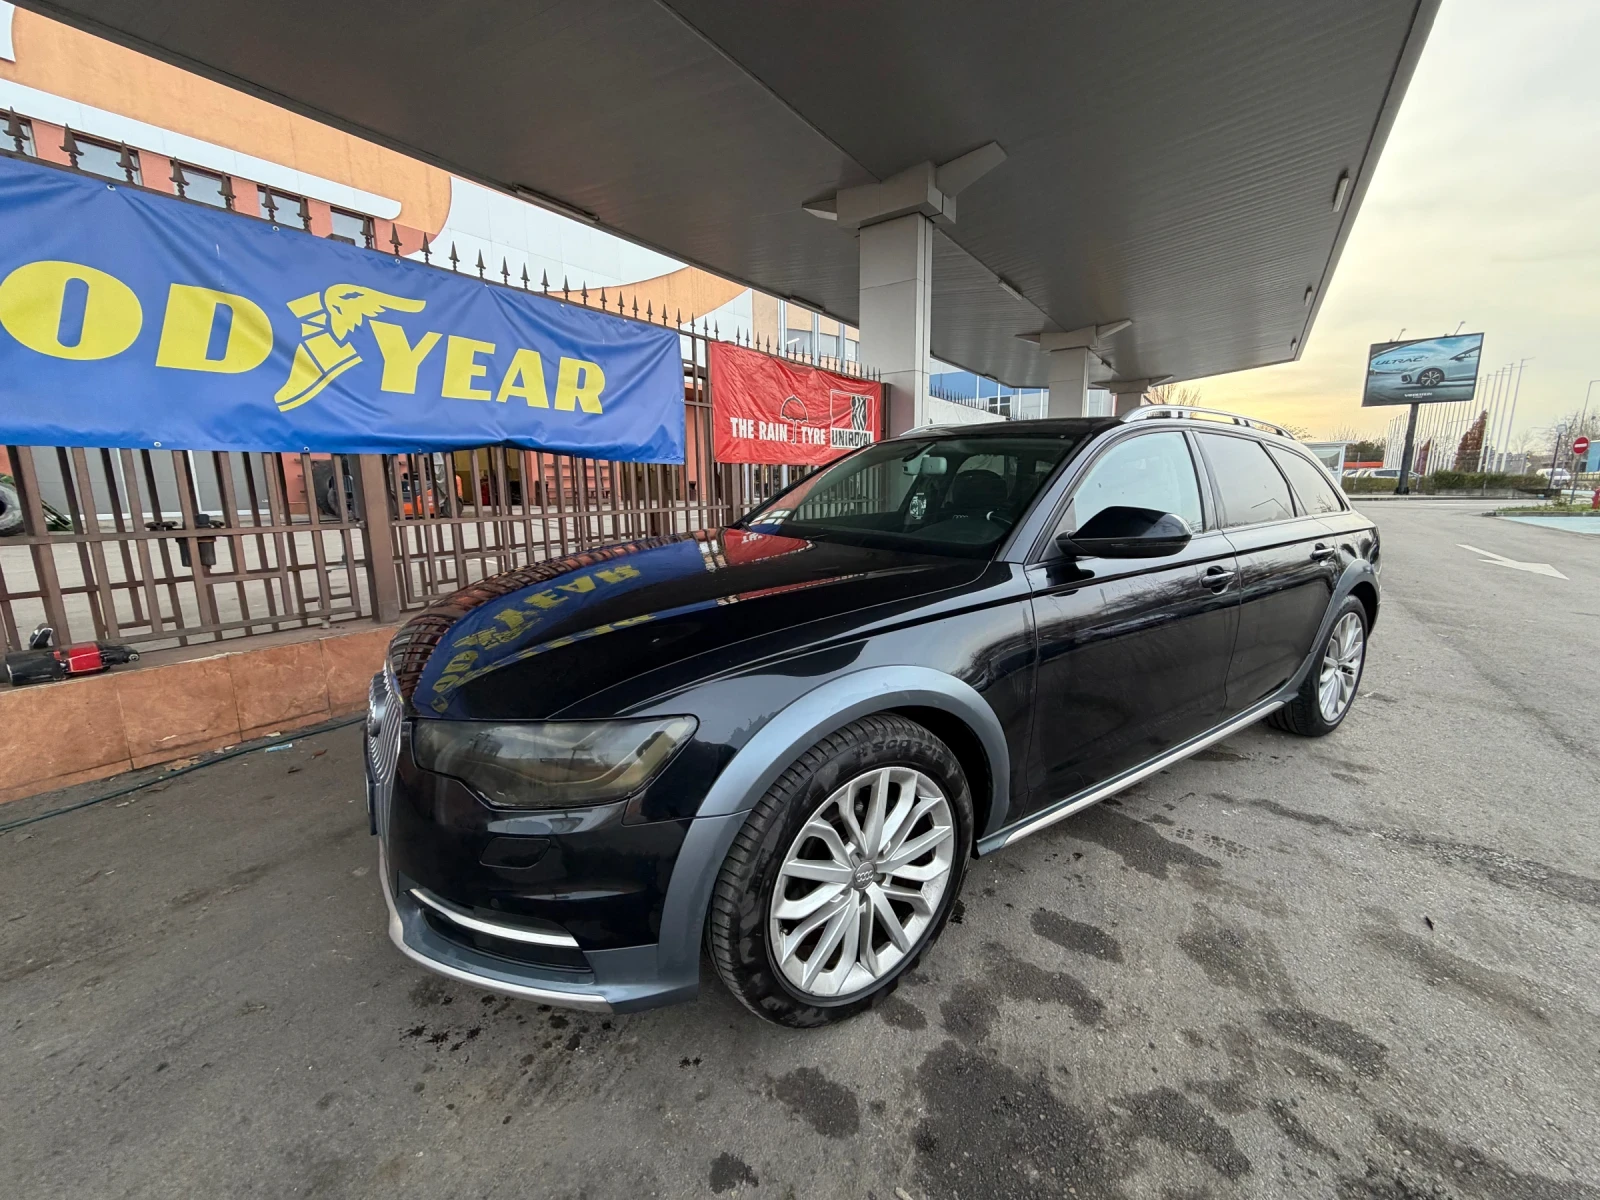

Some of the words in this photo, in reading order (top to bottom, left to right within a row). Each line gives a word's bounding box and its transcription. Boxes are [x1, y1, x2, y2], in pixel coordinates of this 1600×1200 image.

[369, 319, 605, 414] YEAR
[730, 417, 754, 439] THE
[758, 421, 788, 442] RAIN
[801, 426, 826, 445] TYRE
